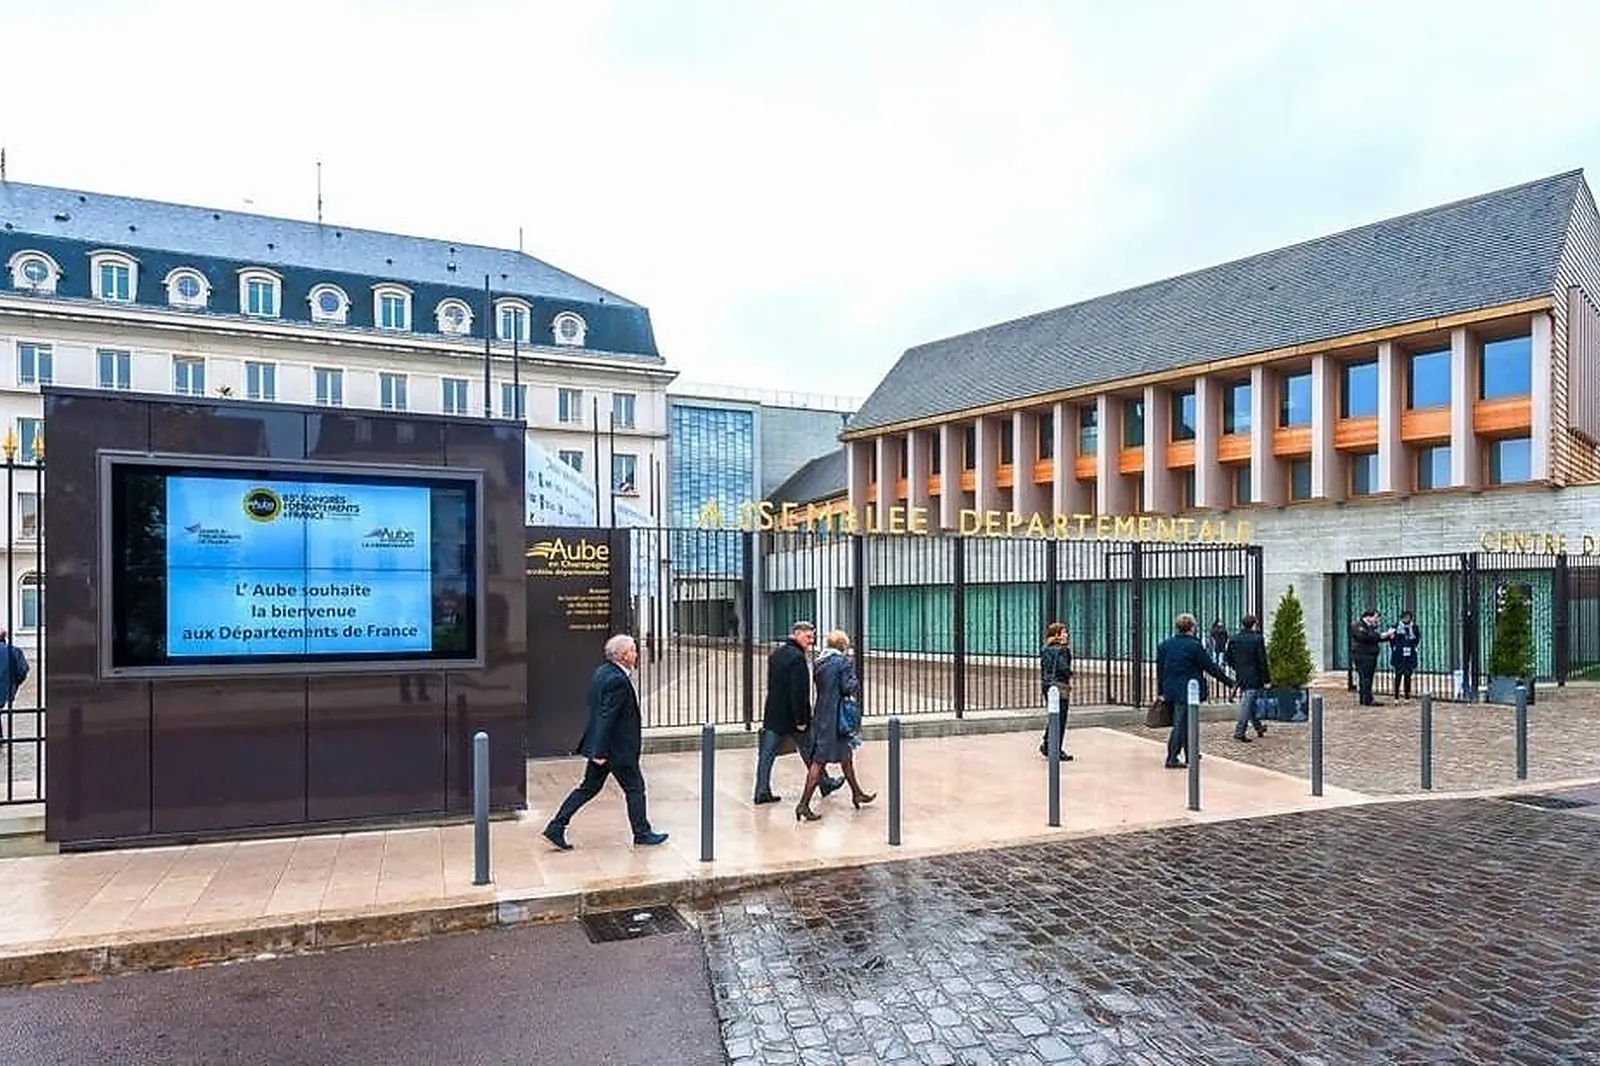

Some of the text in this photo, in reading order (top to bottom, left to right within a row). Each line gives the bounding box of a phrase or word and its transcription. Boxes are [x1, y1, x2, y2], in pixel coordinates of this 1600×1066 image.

[549, 538, 609, 560] Aube
[252, 583, 298, 597] Aube
[302, 583, 372, 598] souhaite
[251, 605, 357, 619] la bienvenue
[182, 624, 419, 642] aux Départements de France
